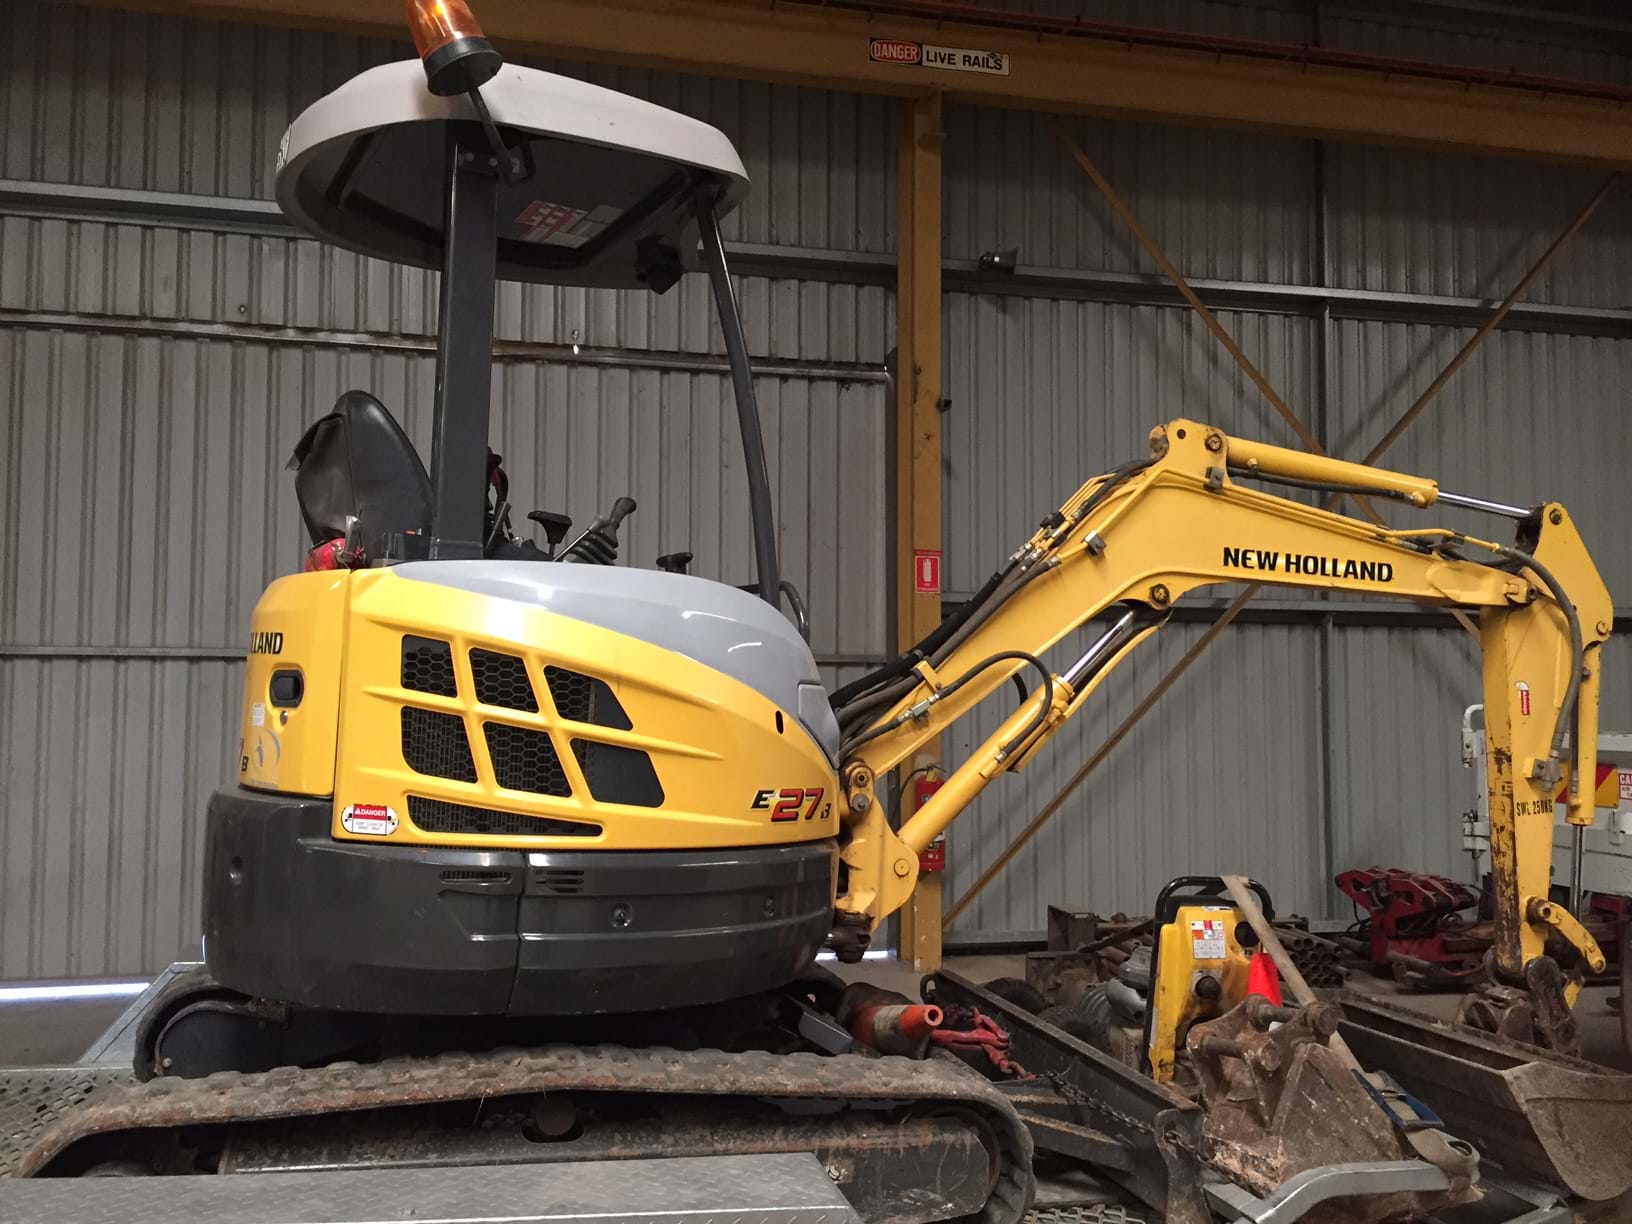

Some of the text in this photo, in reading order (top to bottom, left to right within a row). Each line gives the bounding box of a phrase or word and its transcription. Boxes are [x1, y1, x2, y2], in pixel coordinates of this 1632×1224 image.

[873, 43, 1003, 71] DANGER LIVE RAILS
[1223, 547, 1393, 583] NEW HOLLAND
[1619, 774, 1632, 786] CA
[361, 808, 386, 817] DANGER
